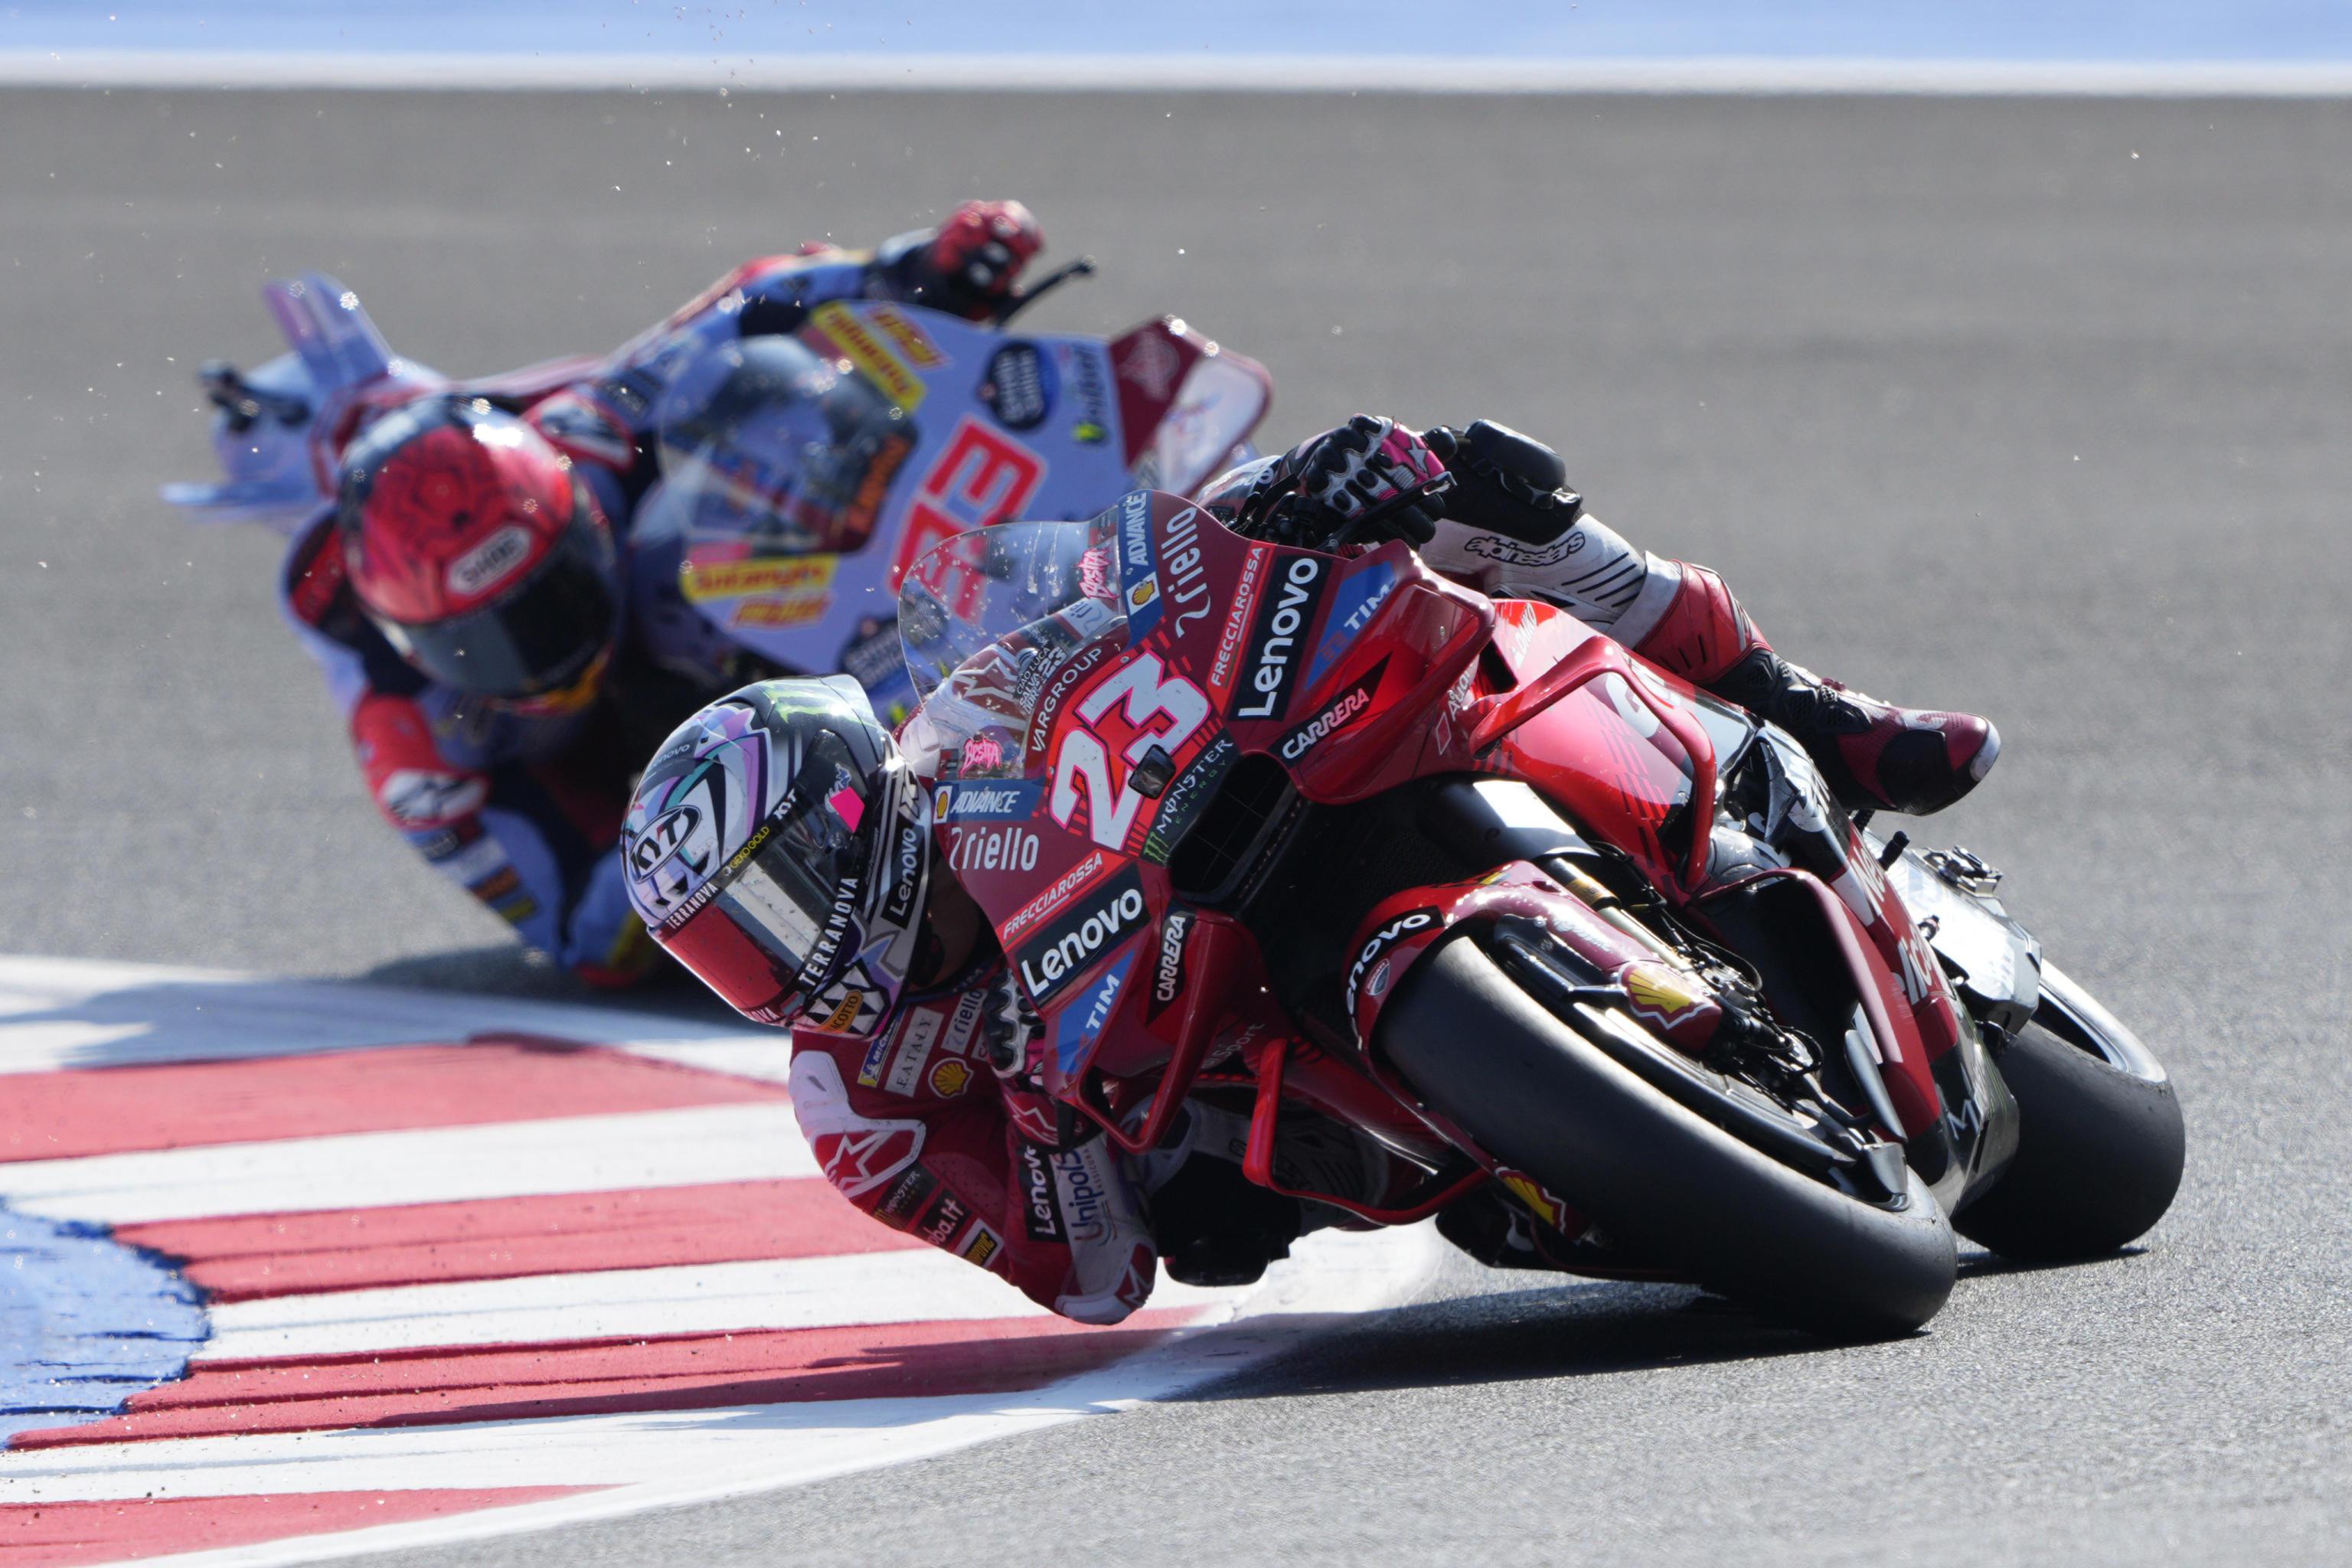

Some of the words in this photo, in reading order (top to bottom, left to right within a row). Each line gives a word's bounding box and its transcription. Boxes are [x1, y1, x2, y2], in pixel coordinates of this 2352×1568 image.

[1126, 492, 1148, 566] ADVANCE
[1161, 507, 1208, 603] riello
[1211, 547, 1263, 686] FRECCIAROSSA
[1238, 557, 1318, 718] Lenovo
[1343, 586, 1391, 631] TIM
[1031, 647, 1102, 752] VARGROUP
[1282, 688, 1370, 760] CARRERA
[1049, 652, 1210, 851] 23
[747, 826, 770, 850] GOLD
[949, 790, 1021, 814] ADVANCE
[890, 828, 918, 918] Lenovo
[962, 827, 1039, 871] riello
[665, 881, 718, 929] TERRANOVA
[799, 877, 858, 987] TERRANOVA
[1002, 851, 1103, 940] FRECCIAROSSA
[1020, 888, 1142, 997] Lenovo
[1157, 915, 1186, 1001] CARRERA
[1086, 973, 1120, 1031] TIM
[896, 1018, 933, 1089] EATALY
